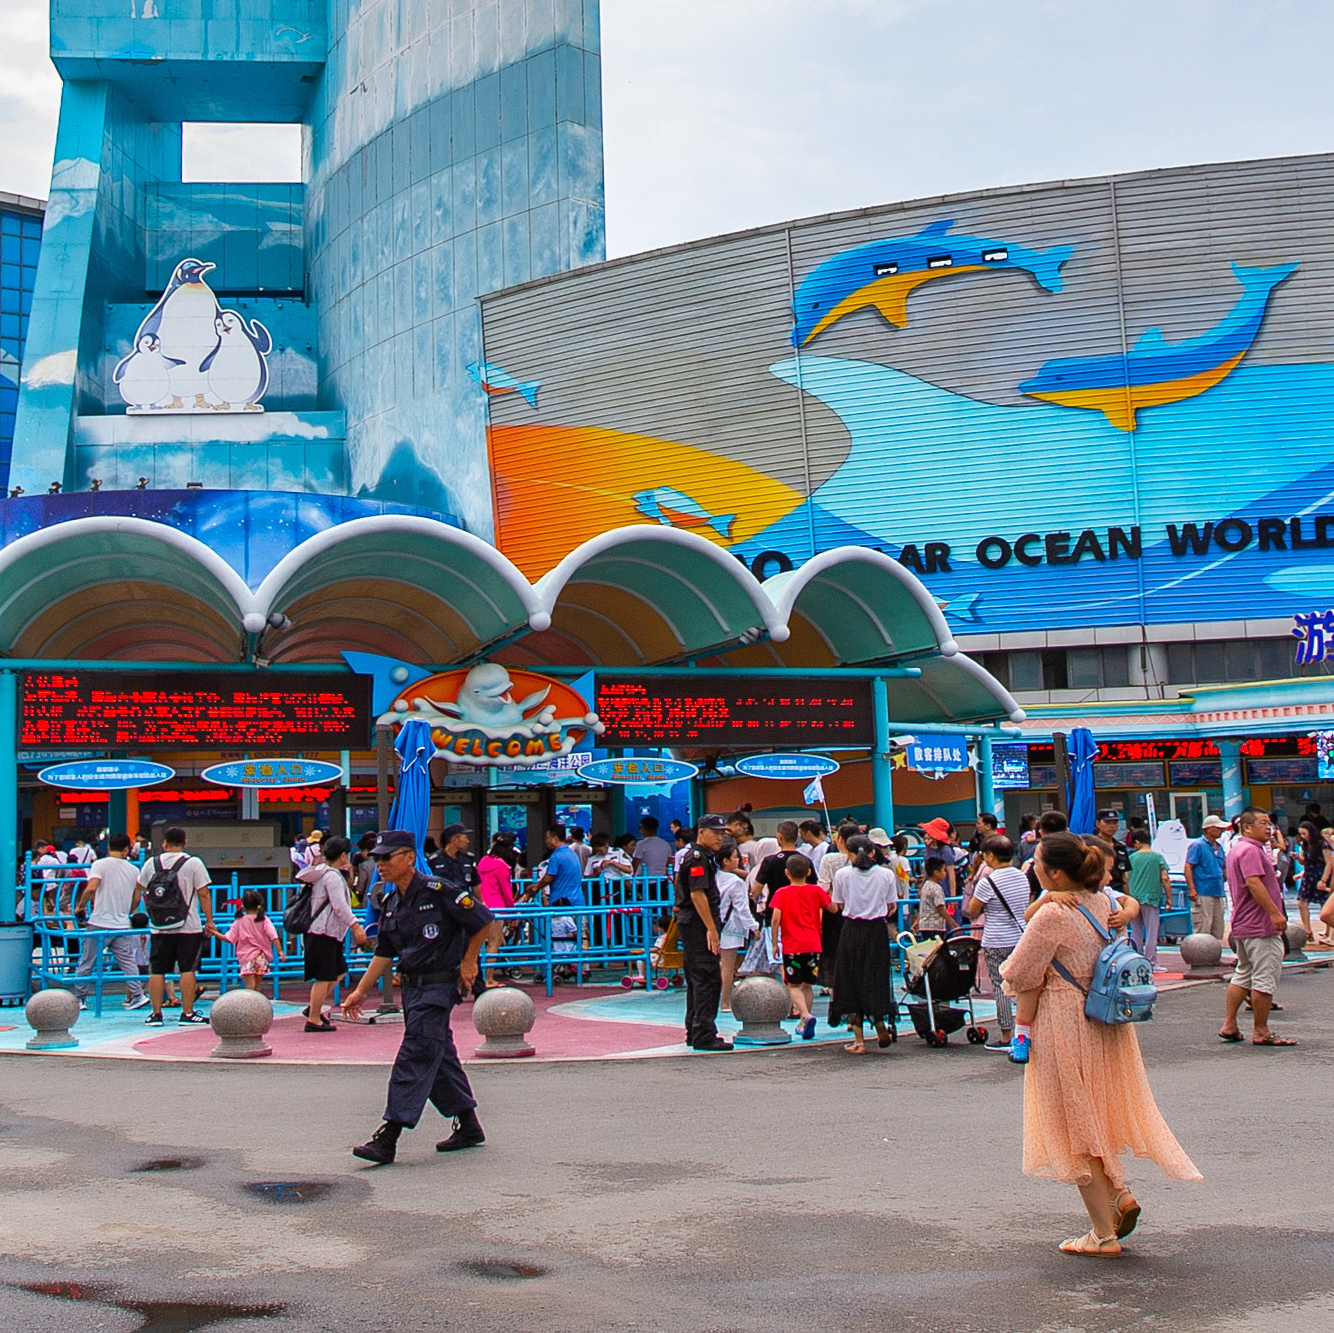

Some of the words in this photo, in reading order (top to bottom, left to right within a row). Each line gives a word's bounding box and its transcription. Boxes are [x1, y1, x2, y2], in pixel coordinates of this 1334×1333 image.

[975, 525, 1142, 570] OCEAN
[430, 728, 563, 757] WELCOME
[913, 746, 962, 763] 散客排队处
